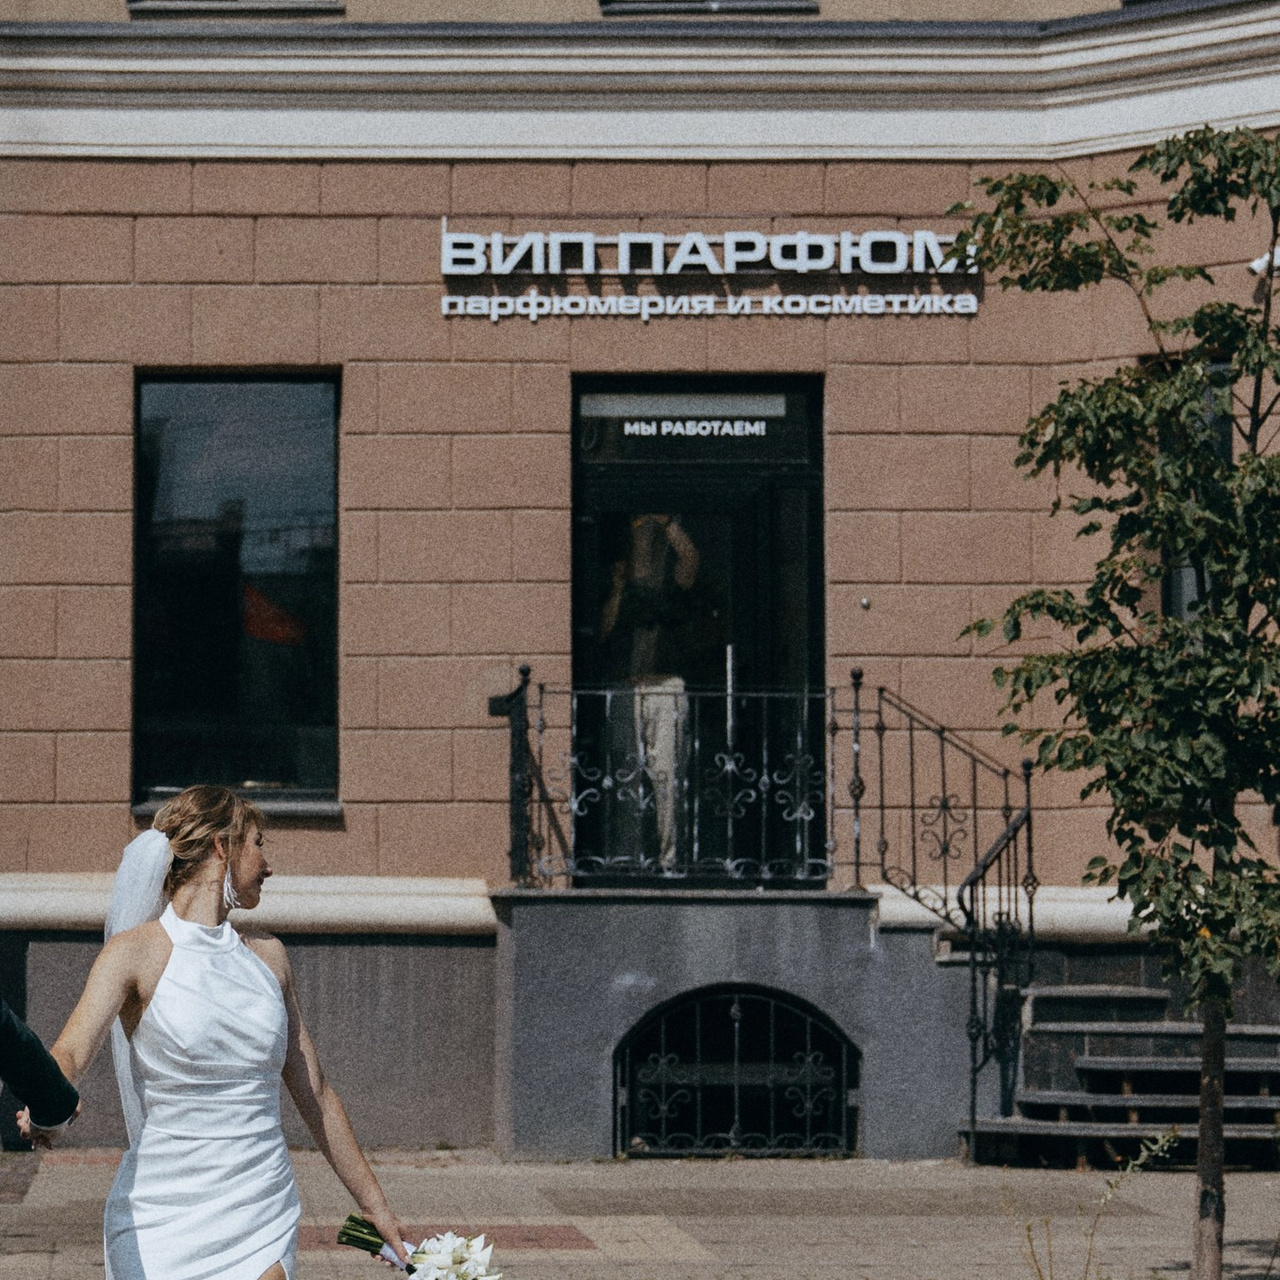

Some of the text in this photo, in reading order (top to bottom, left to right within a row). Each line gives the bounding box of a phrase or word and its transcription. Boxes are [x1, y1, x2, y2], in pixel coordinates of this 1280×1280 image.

[441, 231, 595, 275] ВИП
[441, 289, 979, 322] парфюмерия и косметика
[624, 421, 766, 436] МЫ РАБОТАЕМ!
